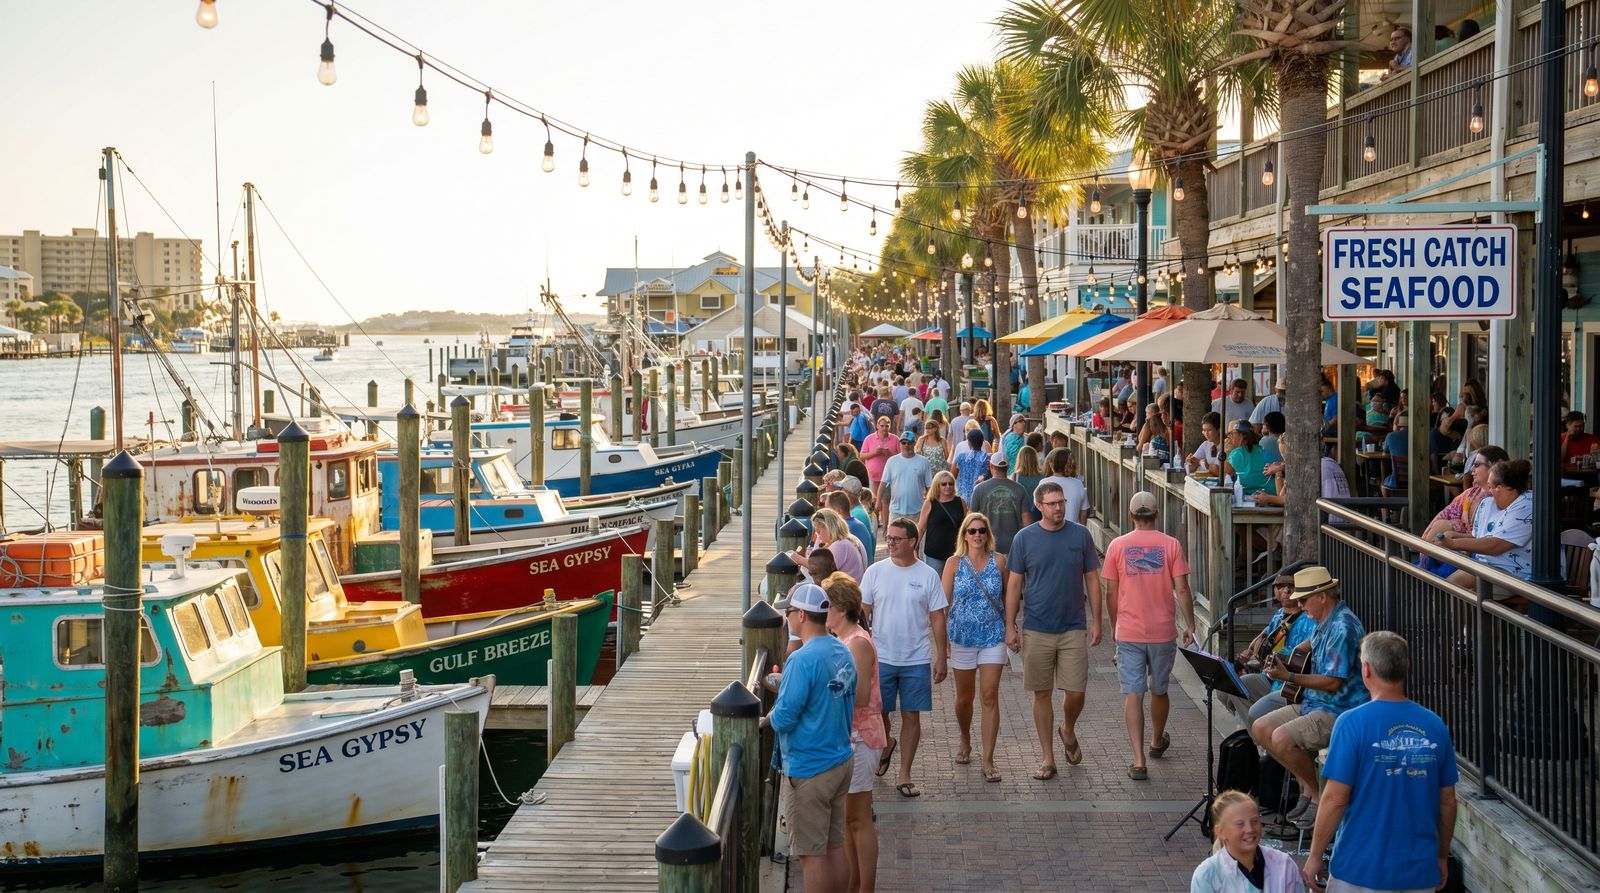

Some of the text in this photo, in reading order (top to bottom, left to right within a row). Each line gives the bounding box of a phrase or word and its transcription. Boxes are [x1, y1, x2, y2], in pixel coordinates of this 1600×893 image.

[1334, 236, 1506, 268] FRESH CATCH
[1340, 275, 1500, 310] SEAFOOD
[654, 467, 670, 476] SEA
[529, 545, 612, 575] SEA GYPSY
[429, 630, 551, 673] GULF BREEZE
[279, 718, 427, 773] SEA GYPSY
